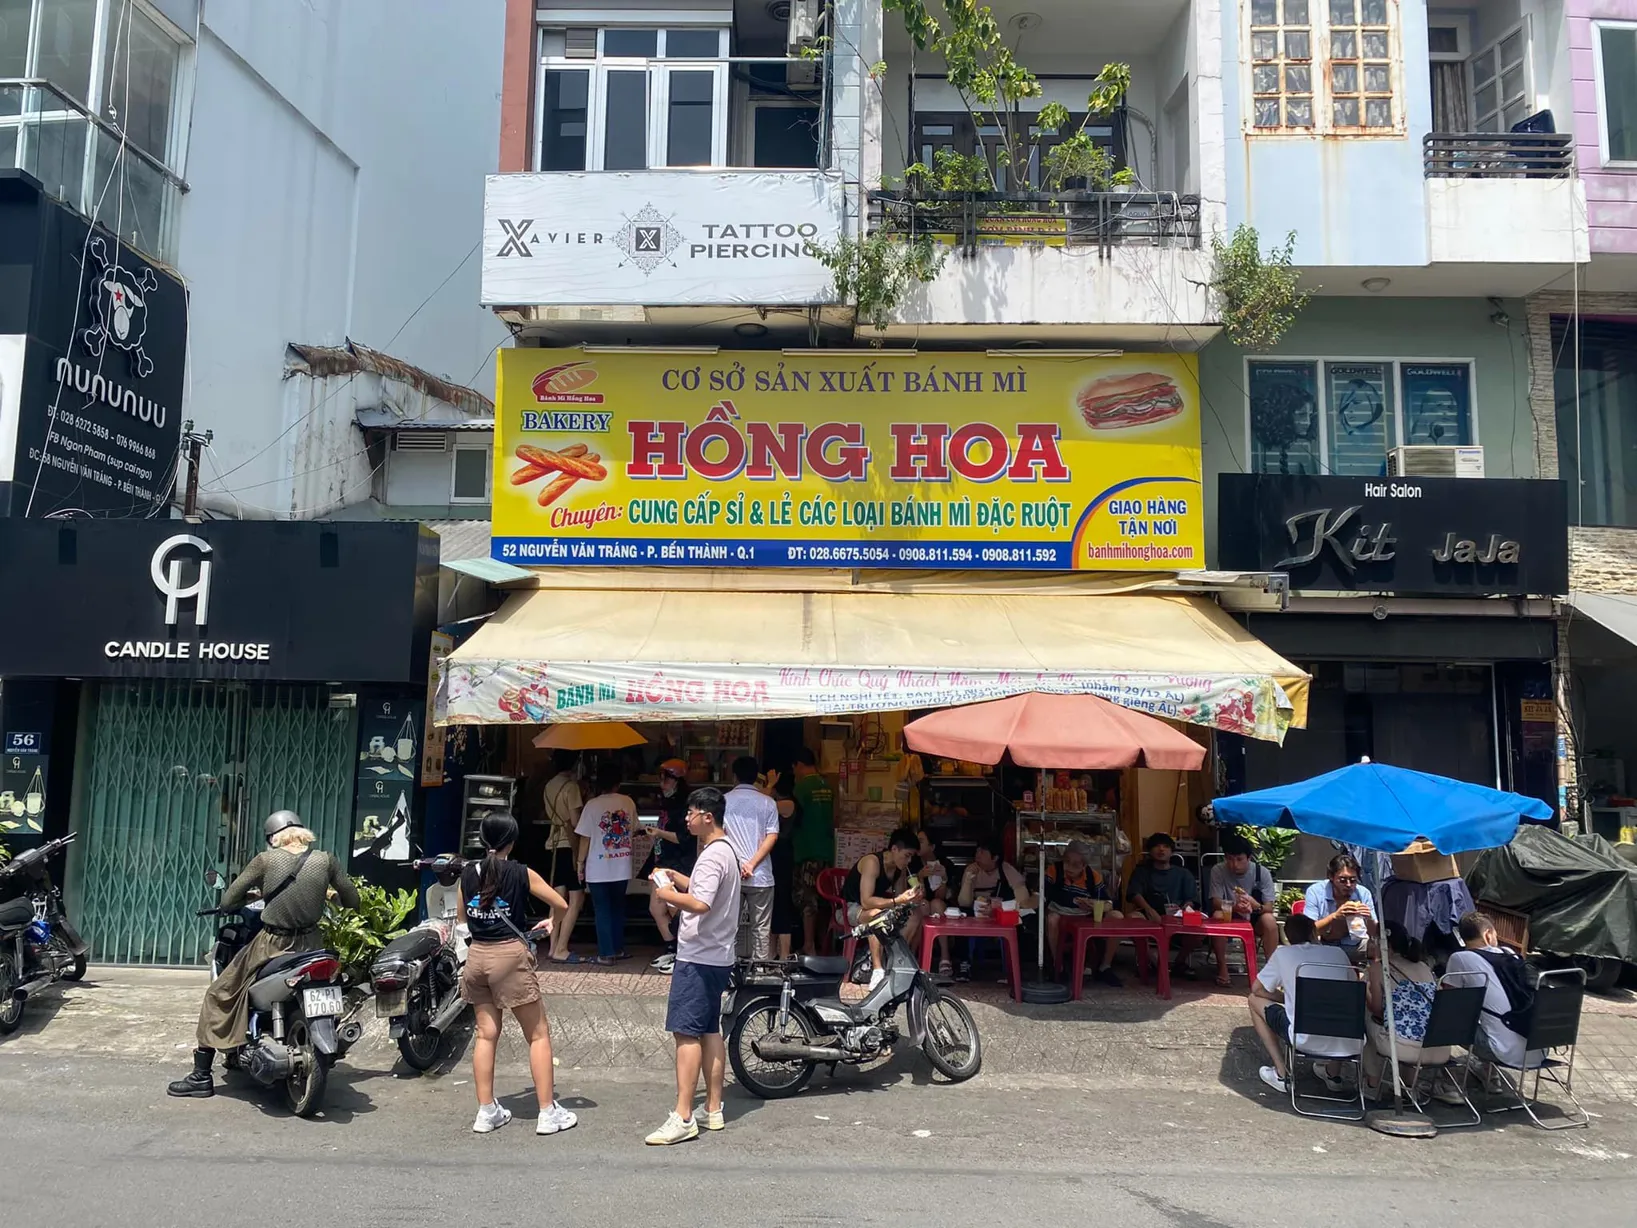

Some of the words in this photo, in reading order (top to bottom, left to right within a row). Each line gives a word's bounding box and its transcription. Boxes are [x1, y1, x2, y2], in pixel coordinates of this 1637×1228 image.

[702, 223, 818, 238] TATTOO
[662, 367, 701, 391] CƠ
[709, 361, 745, 391] SỞ
[754, 362, 811, 392] SẢN
[819, 361, 895, 392] XUẤT
[903, 365, 983, 393] BÁNH
[993, 365, 1027, 393] MÌ
[56, 357, 166, 429] nununuu
[60, 410, 74, 425] 028
[75, 417, 92, 433] 6272
[92, 423, 109, 440] 5858
[116, 434, 127, 448] 076
[523, 412, 611, 430] BAKERY
[49, 431, 60, 443] FB
[60, 435, 83, 453] Ngan
[83, 444, 106, 461] Pham
[107, 454, 123, 470] (sup
[626, 401, 873, 481] HỒNG
[890, 422, 1072, 482] HOA
[1365, 483, 1387, 498] Hair
[1391, 483, 1422, 499] Salon
[550, 503, 624, 530] Chuyên:
[628, 499, 678, 525] CUNG
[684, 490, 721, 526] CẤP
[726, 492, 744, 526] SỈ
[749, 501, 764, 526] &
[769, 492, 792, 526] LẺ
[799, 493, 836, 526] CÁC
[843, 502, 885, 530] LOẠI
[892, 495, 942, 527] BÁNH
[950, 496, 971, 527] MÌ
[976, 497, 1015, 534] ĐẶC
[1021, 496, 1072, 531] RUỘT
[1109, 500, 1143, 515] GIAO
[1147, 496, 1187, 515] HÀNG
[1119, 516, 1147, 538] TẬN
[1152, 519, 1178, 535] NƠI
[502, 545, 517, 557] 52
[519, 538, 567, 558] NGUYỄN
[571, 541, 595, 558] VĂN
[598, 541, 637, 559] TRÁNG
[647, 546, 659, 559] P.
[661, 539, 685, 559] BẾN
[688, 542, 727, 560] THÀNH
[737, 546, 755, 561] Q.1
[1273, 504, 1399, 573] Kit
[1431, 532, 1520, 565] JaJa
[787, 546, 807, 560] ĐT:
[810, 547, 889, 561] 028.6675.5054
[899, 548, 972, 561] 0908.811.594
[982, 549, 1057, 562] 0908.811.592
[1088, 543, 1193, 562] banhmihonghoa.com
[104, 641, 190, 658] CANDLE
[199, 642, 270, 660] HOUSE
[556, 682, 594, 709] BÁNH
[625, 671, 704, 704] HỒNG
[713, 680, 769, 704] HOA
[779, 667, 811, 686] Kính
[858, 669, 889, 691] Quý
[896, 669, 940, 688] Khách
[12, 734, 34, 746] 56
[309, 988, 336, 1001] 62-P1
[307, 1001, 341, 1015] 170.60
